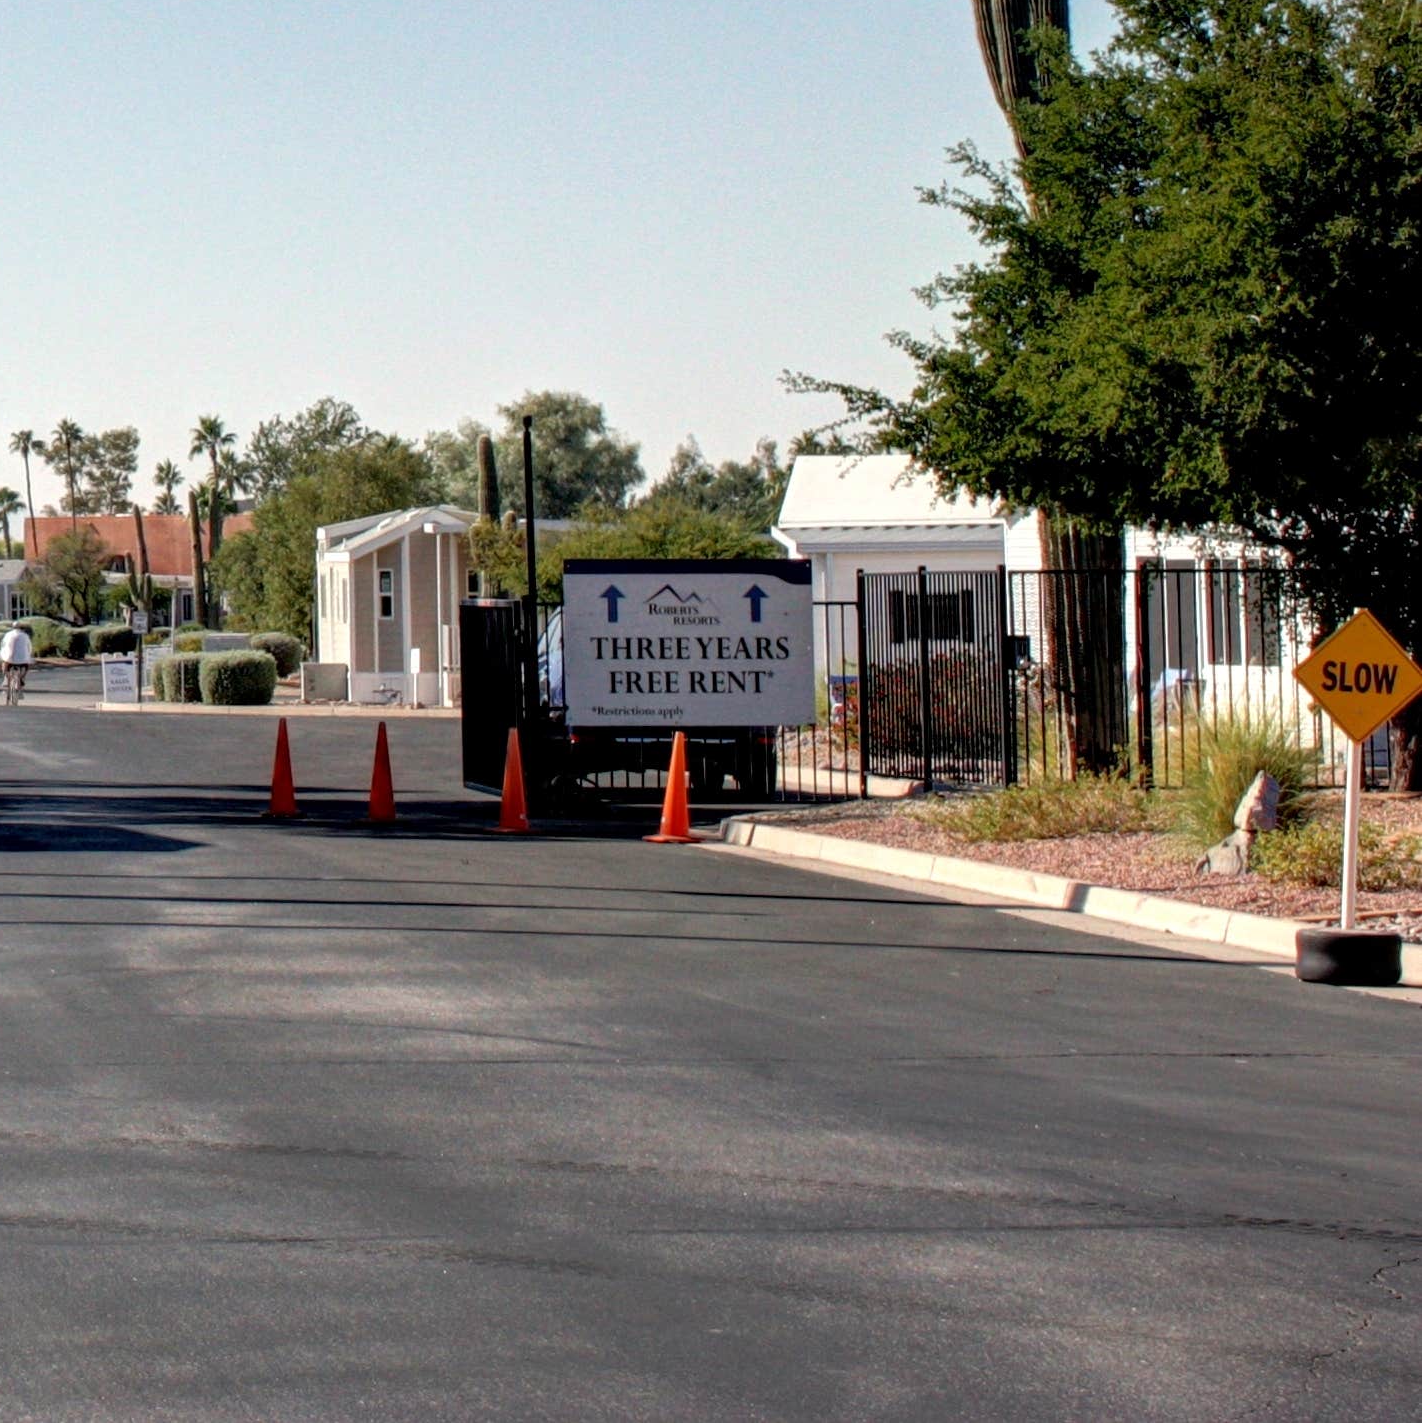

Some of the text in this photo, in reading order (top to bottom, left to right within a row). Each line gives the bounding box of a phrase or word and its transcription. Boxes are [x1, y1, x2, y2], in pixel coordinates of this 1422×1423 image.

[673, 616, 721, 626] RESORTS
[590, 636, 790, 660] THREE YEARS
[609, 671, 680, 694] FREE
[1321, 660, 1398, 695] SLOW
[657, 706, 684, 719] apply
